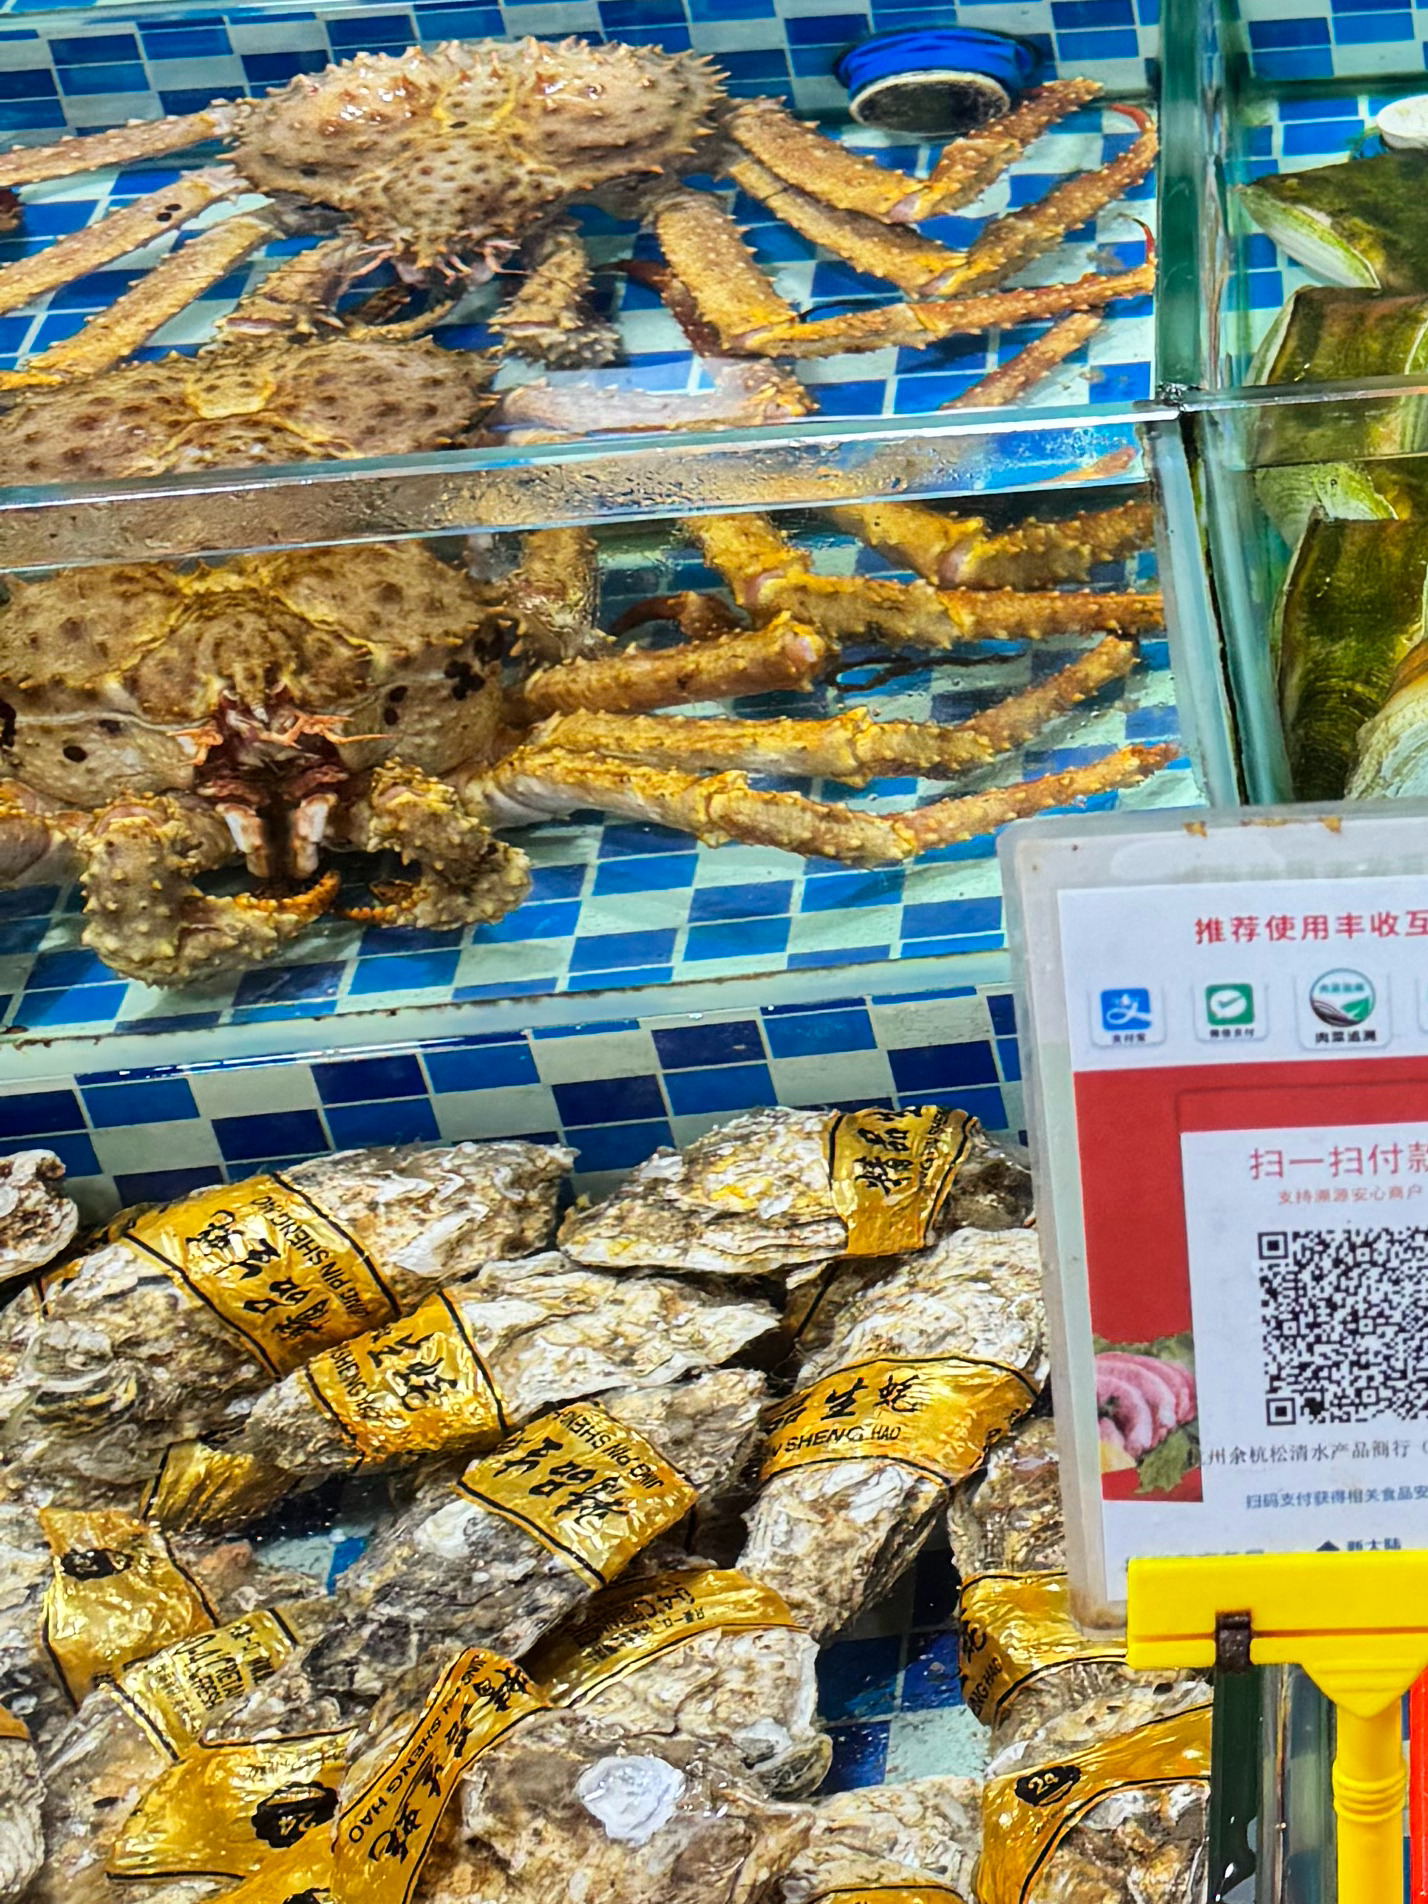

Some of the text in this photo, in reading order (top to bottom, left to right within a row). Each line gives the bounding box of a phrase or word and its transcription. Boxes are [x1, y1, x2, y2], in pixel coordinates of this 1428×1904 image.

[319, 1261, 350, 1291] PIN
[785, 1426, 866, 1452] SHENG
[871, 1425, 901, 1441] HAO
[386, 1717, 441, 1794] SHENG
[349, 1796, 388, 1843] HAO
